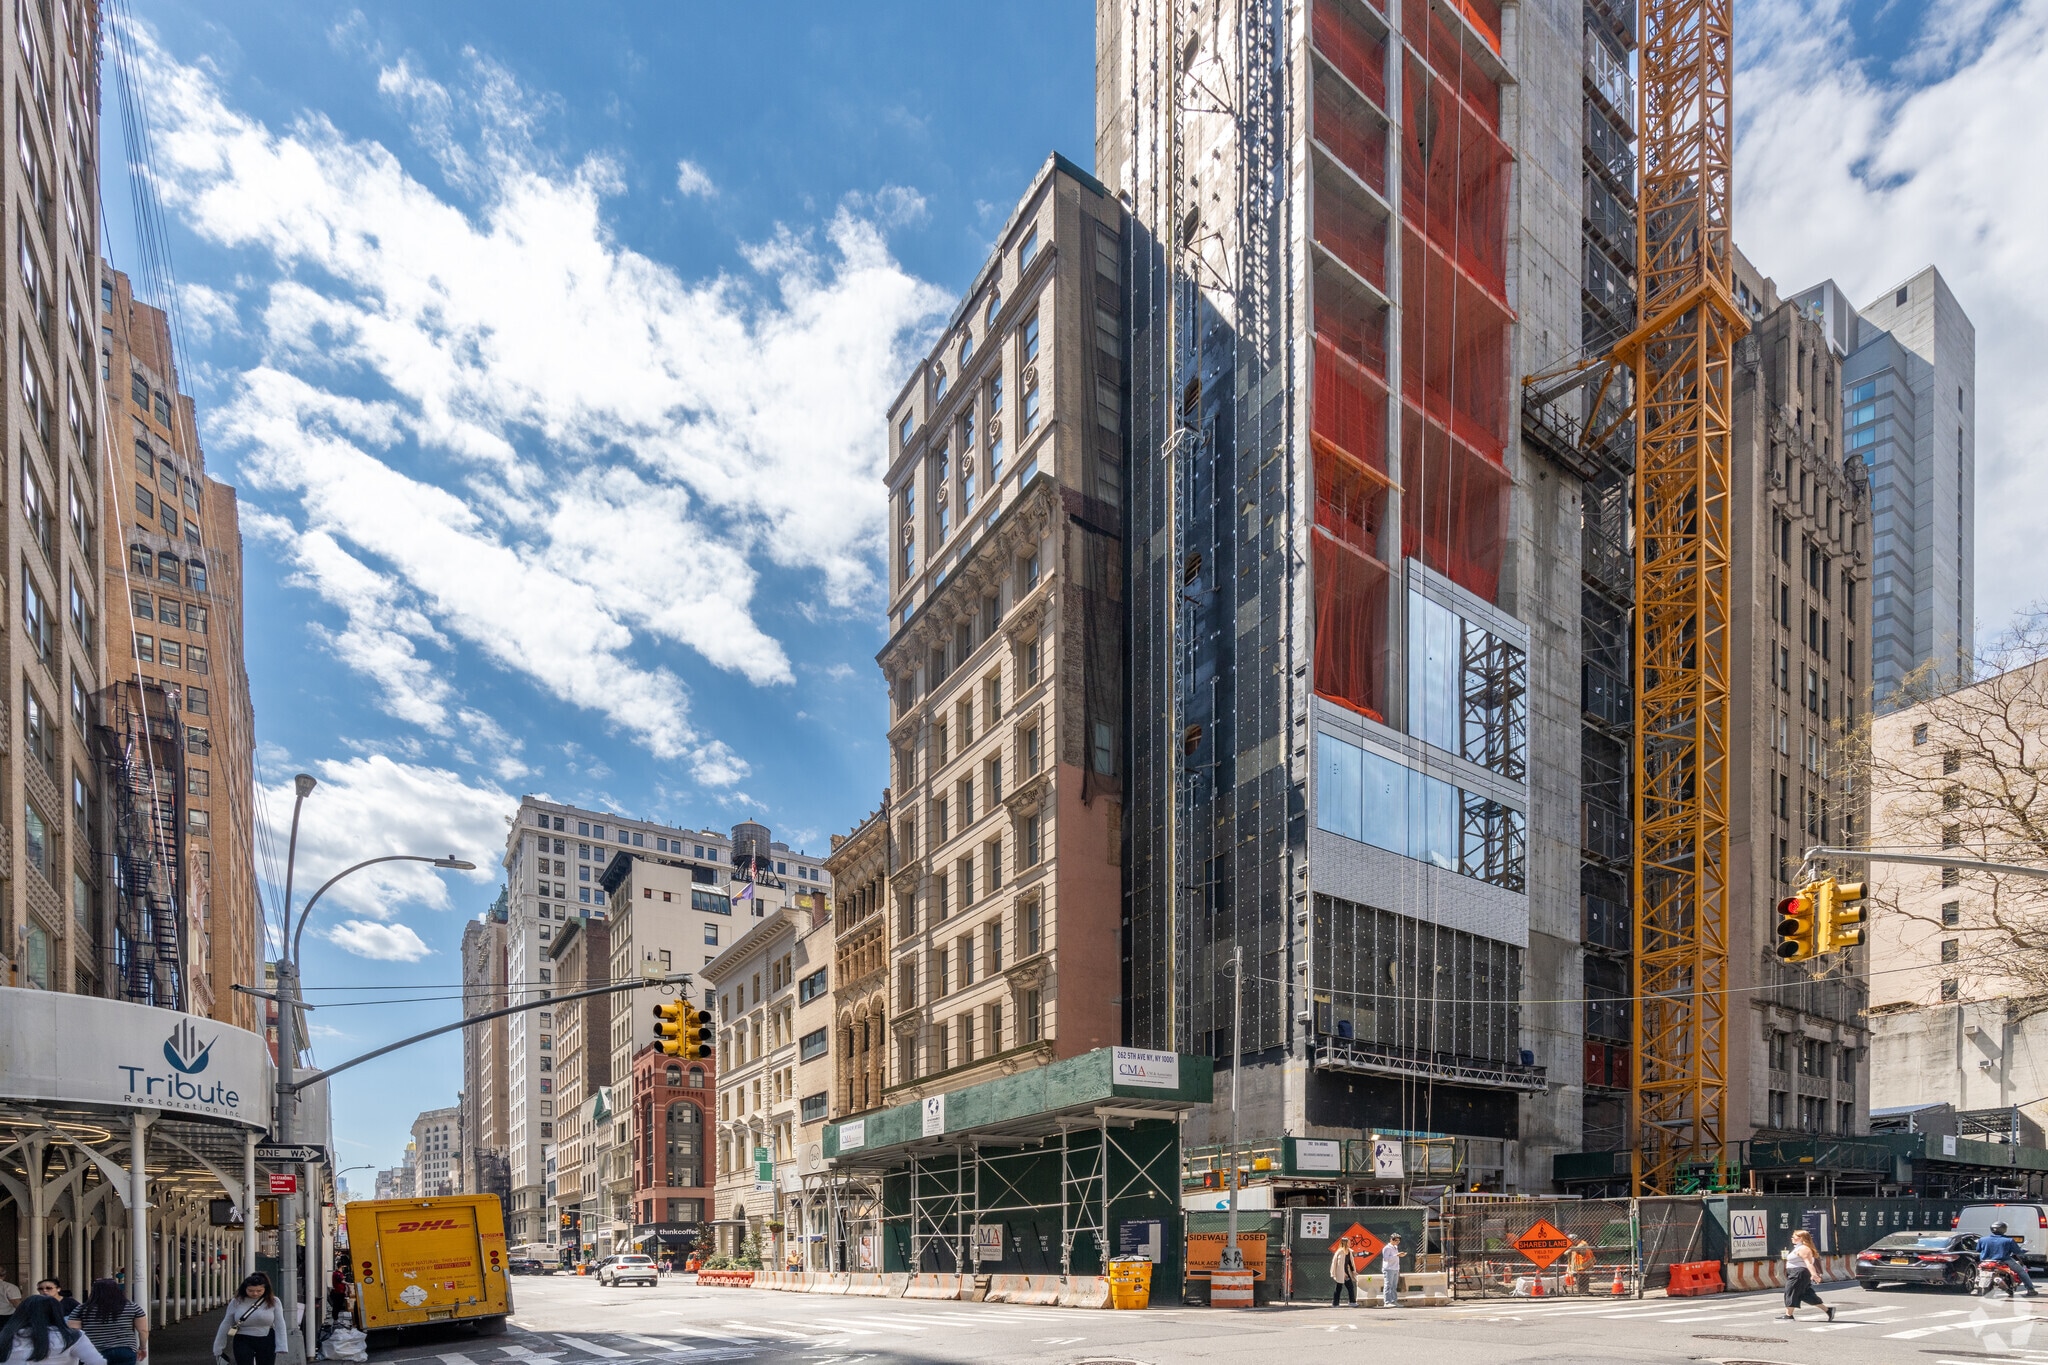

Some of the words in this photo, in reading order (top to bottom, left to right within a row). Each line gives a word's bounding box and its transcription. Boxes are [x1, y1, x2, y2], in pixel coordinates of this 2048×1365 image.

[1118, 1051, 1126, 1059] 262
[1120, 1064, 1146, 1076] CMA
[118, 1065, 240, 1108] Tribute
[124, 1094, 218, 1113] Restoration
[225, 1109, 241, 1118] Inc.
[398, 1219, 458, 1233] DHL
[1733, 1215, 1766, 1236] CMA
